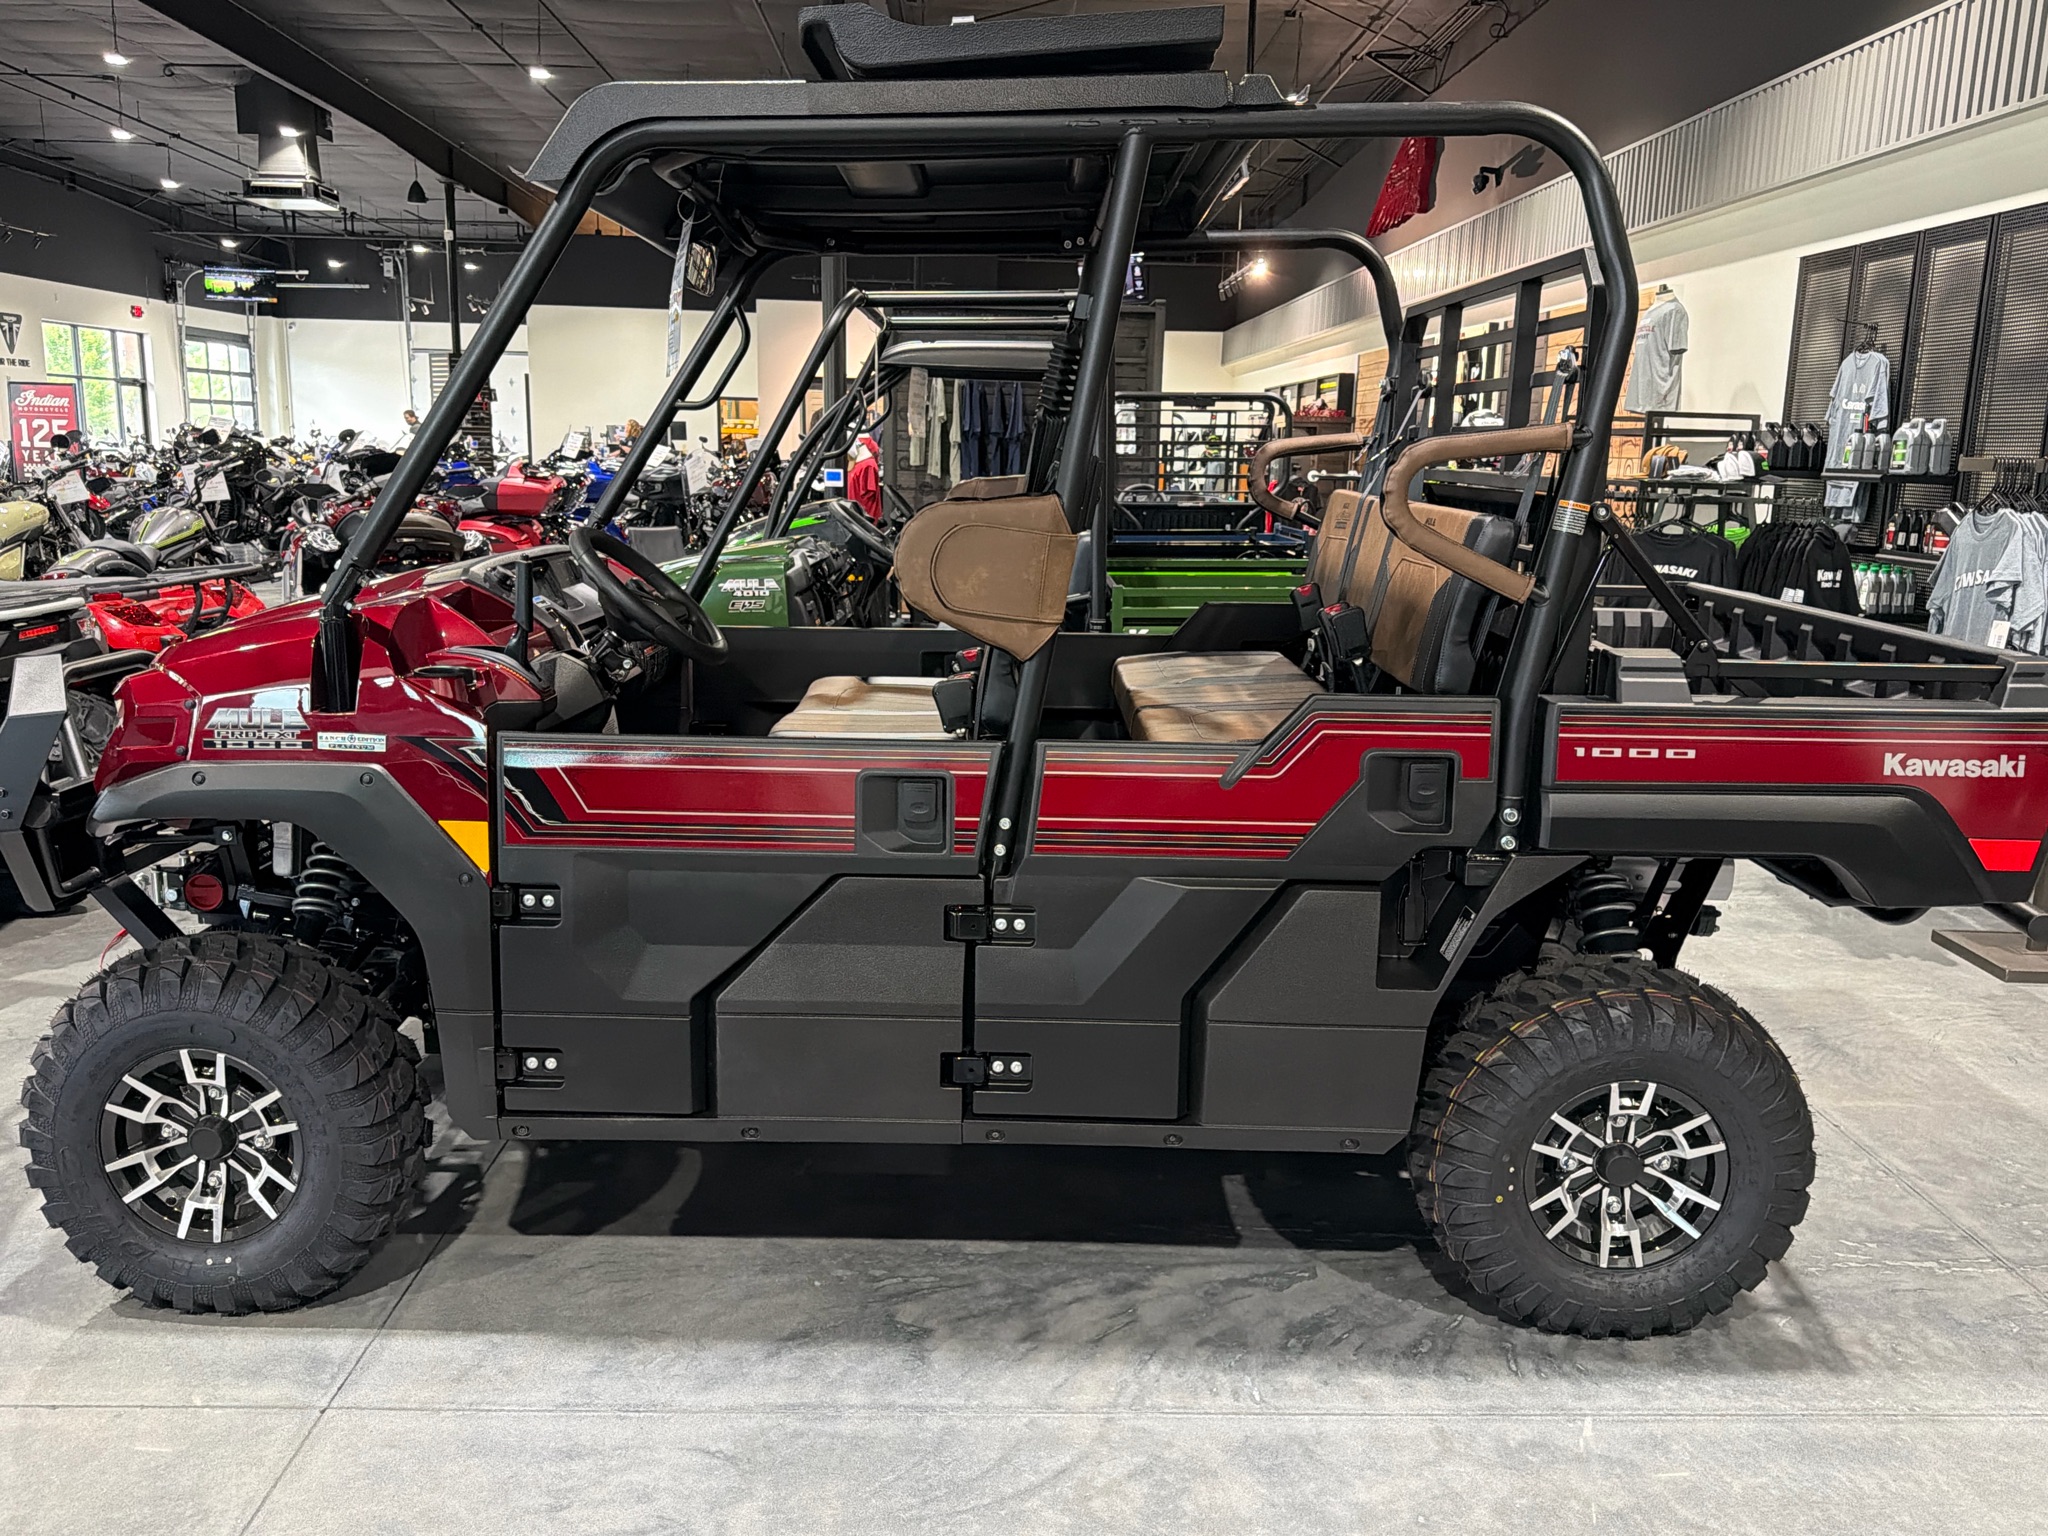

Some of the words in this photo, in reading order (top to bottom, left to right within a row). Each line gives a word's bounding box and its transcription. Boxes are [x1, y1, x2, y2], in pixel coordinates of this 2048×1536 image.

[15, 390, 70, 407] Indian
[720, 578, 781, 592] MULE
[204, 707, 311, 730] MULE
[213, 740, 303, 749] 1000
[1573, 746, 1696, 760] 1000
[1883, 752, 2026, 779] Kawasaki
